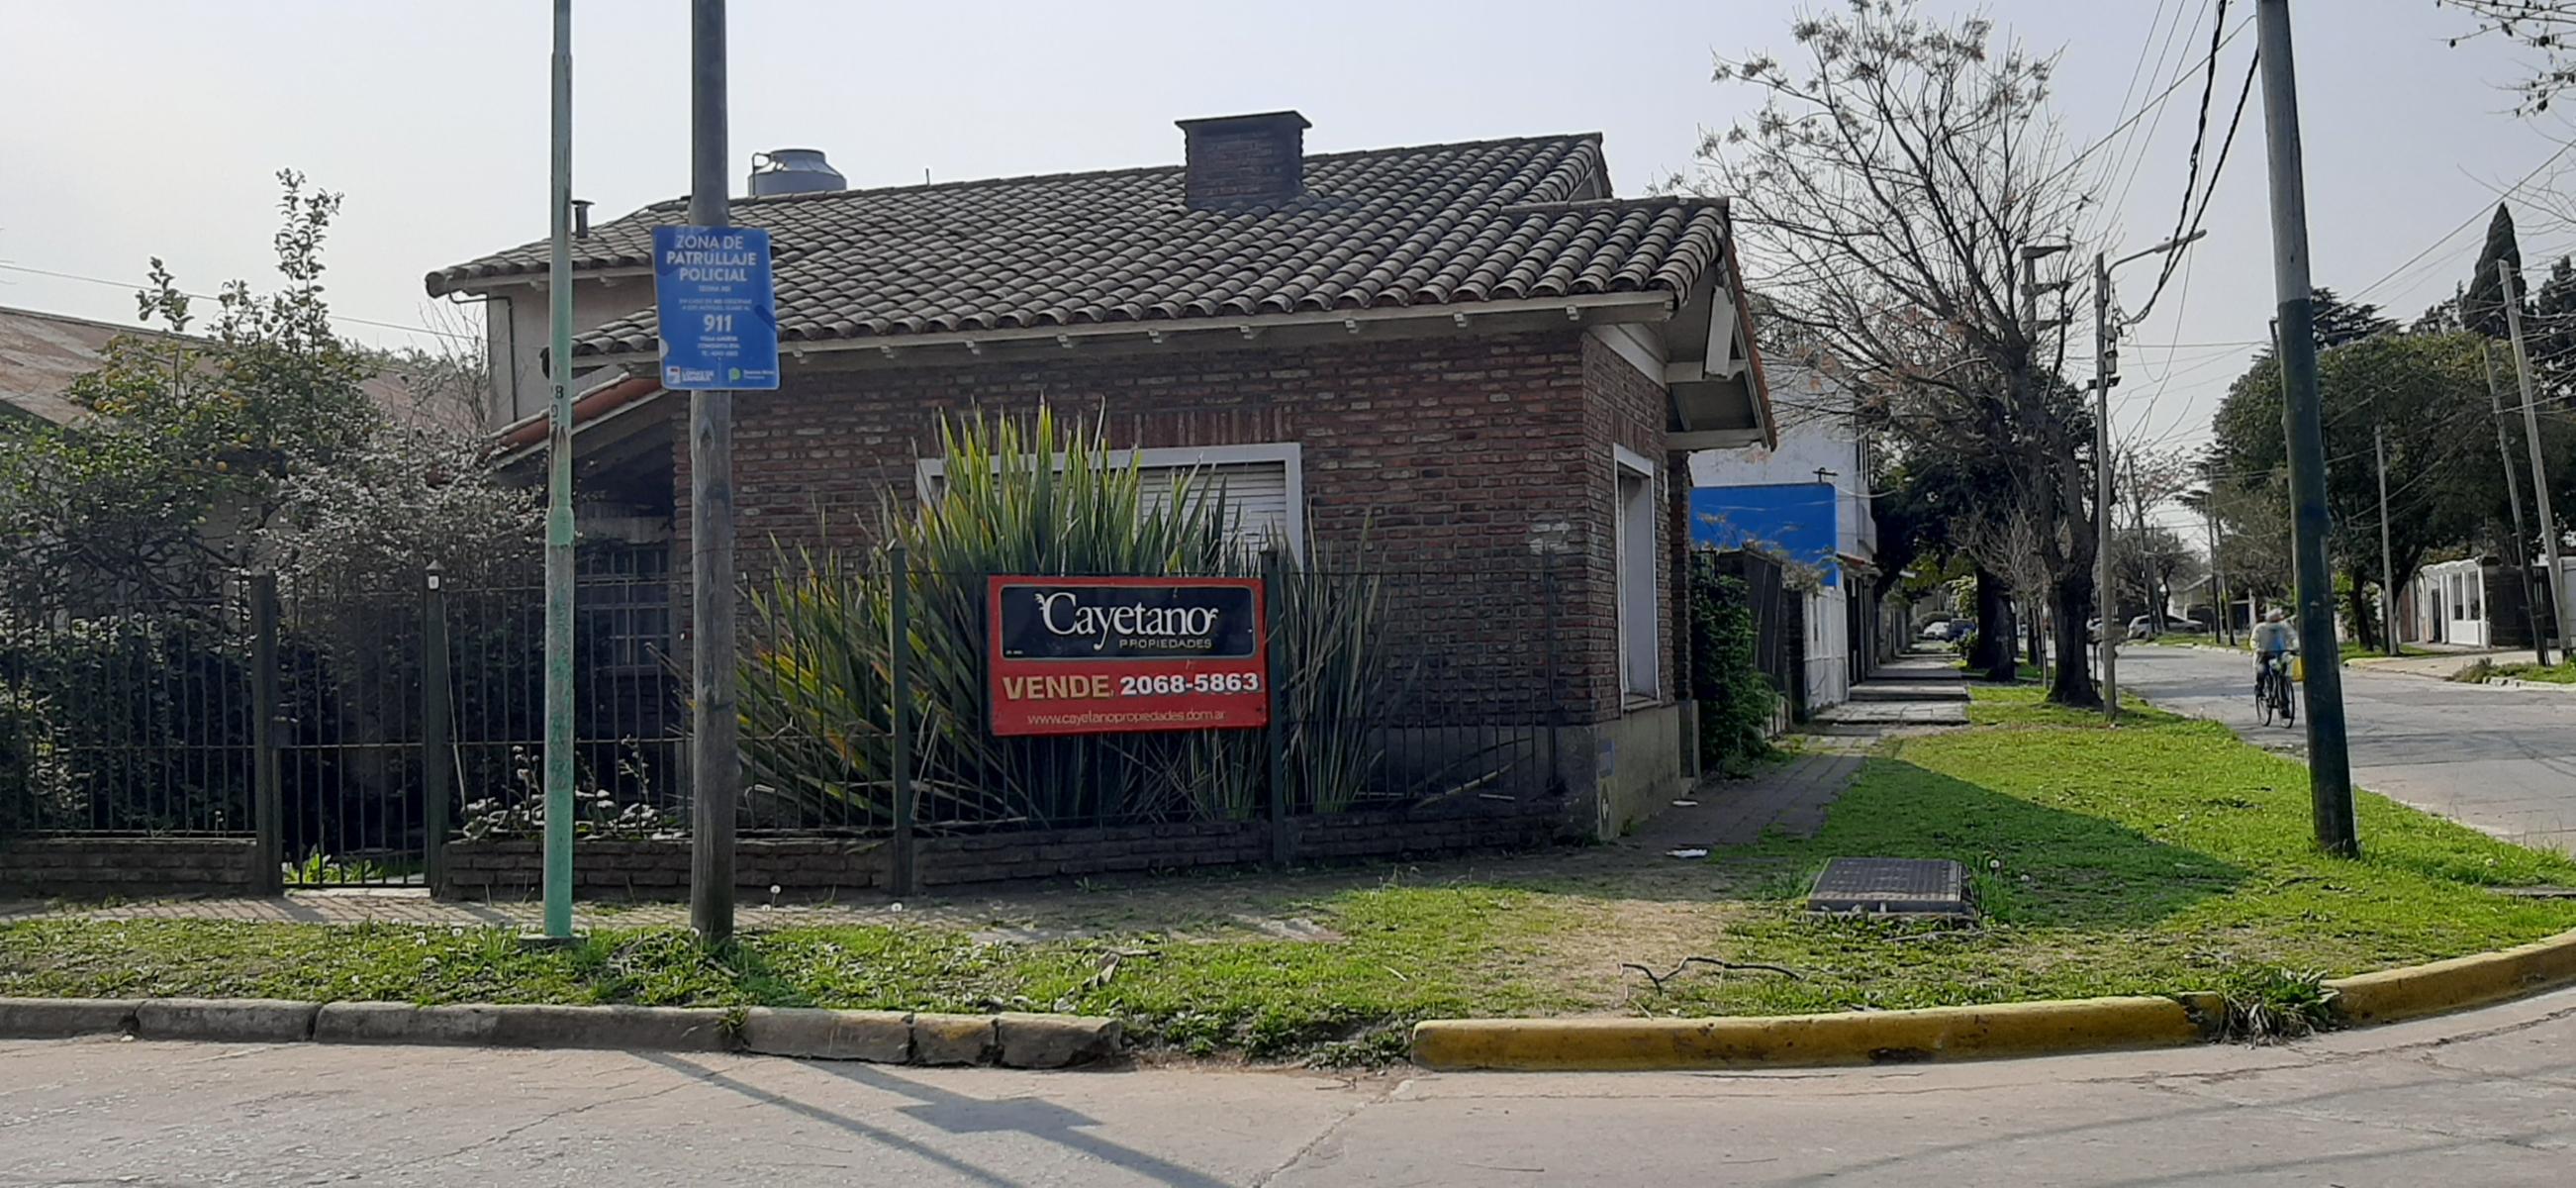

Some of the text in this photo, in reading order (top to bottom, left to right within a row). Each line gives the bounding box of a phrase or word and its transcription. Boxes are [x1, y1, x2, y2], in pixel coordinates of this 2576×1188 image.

[675, 235, 744, 250] ZONA DE
[666, 250, 757, 266] PATRULLAJE
[679, 267, 748, 282] POLICIAL
[704, 314, 732, 333] 911
[1035, 591, 1219, 651] Cayetano
[1119, 638, 1213, 649] PROPIEDADES
[1002, 671, 1260, 700] VENDE 2068-5863
